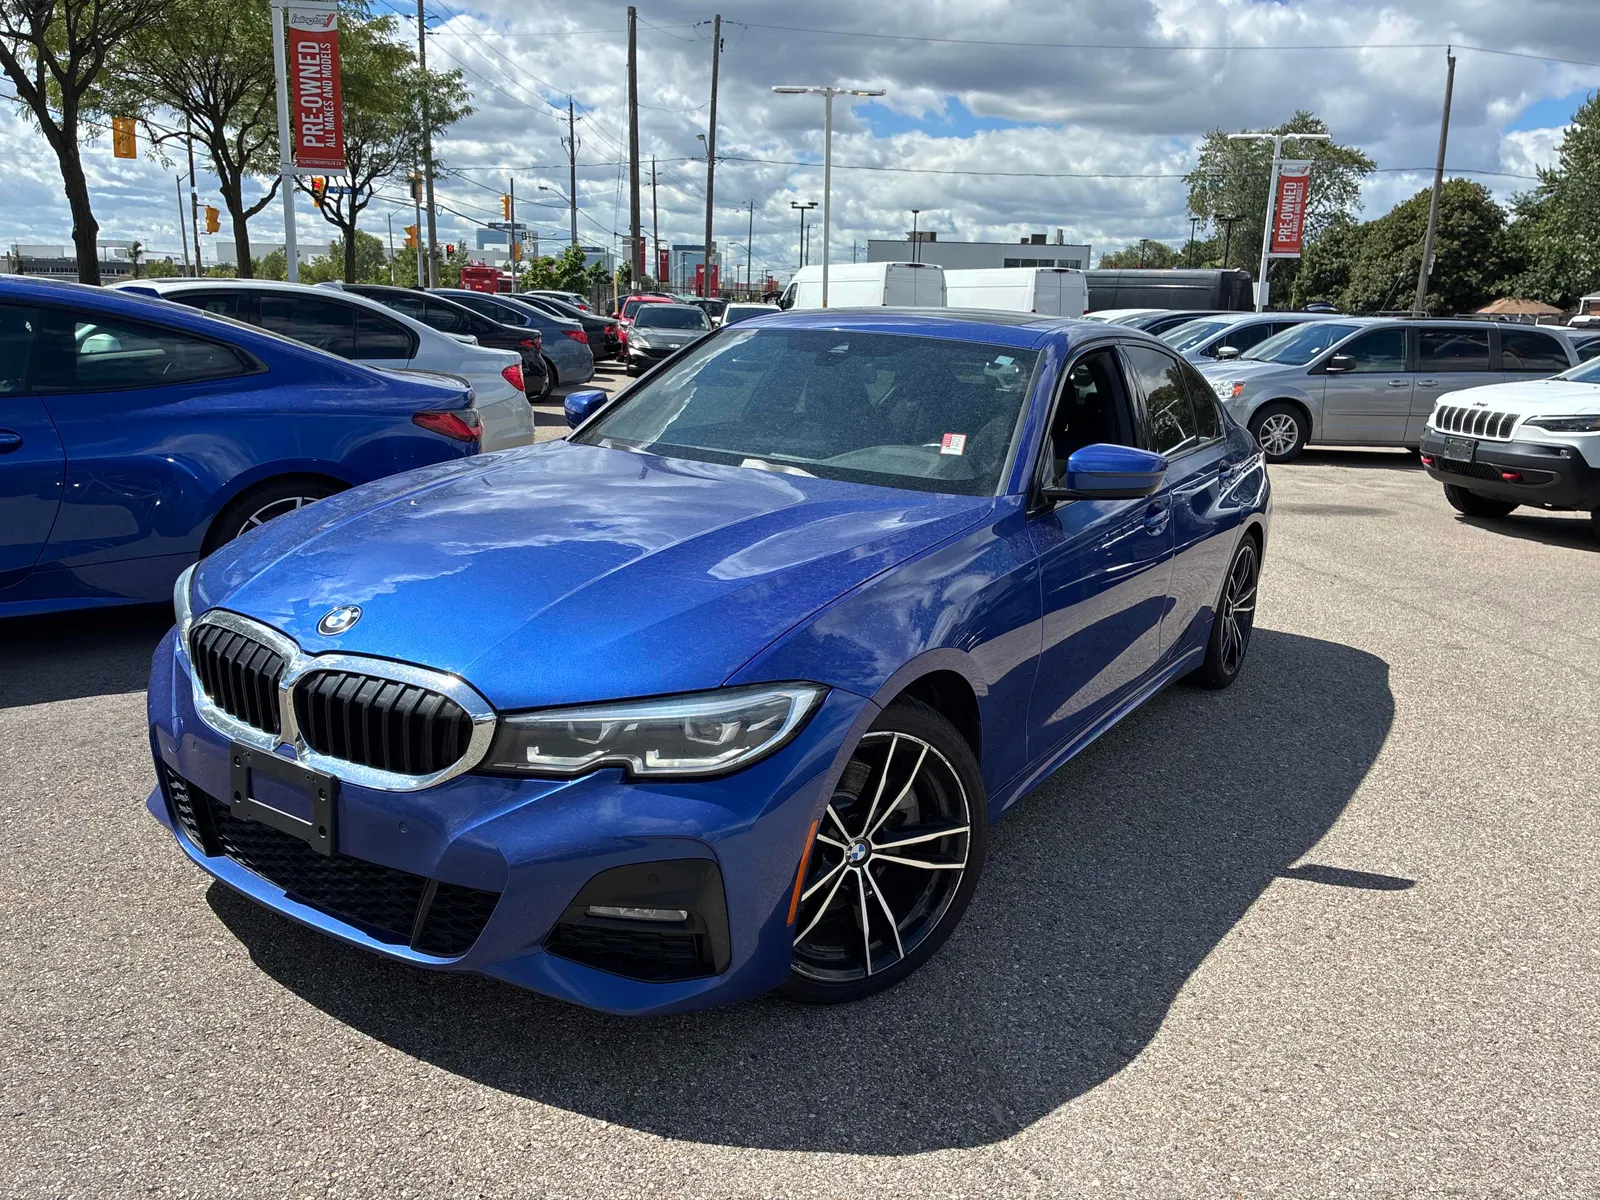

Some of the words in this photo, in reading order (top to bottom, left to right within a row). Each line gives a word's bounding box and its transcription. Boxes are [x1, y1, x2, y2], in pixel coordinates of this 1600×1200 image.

[320, 42, 333, 78] MODELS
[297, 41, 325, 147] PRE-OWNED
[322, 80, 334, 98] AND
[323, 100, 335, 130] MAKES
[324, 132, 336, 148] ALL
[1296, 182, 1304, 202] MODELS
[1278, 182, 1298, 242] PRE-OWNED
[1292, 214, 1300, 232] MAKES
[1291, 233, 1299, 242] ALL
